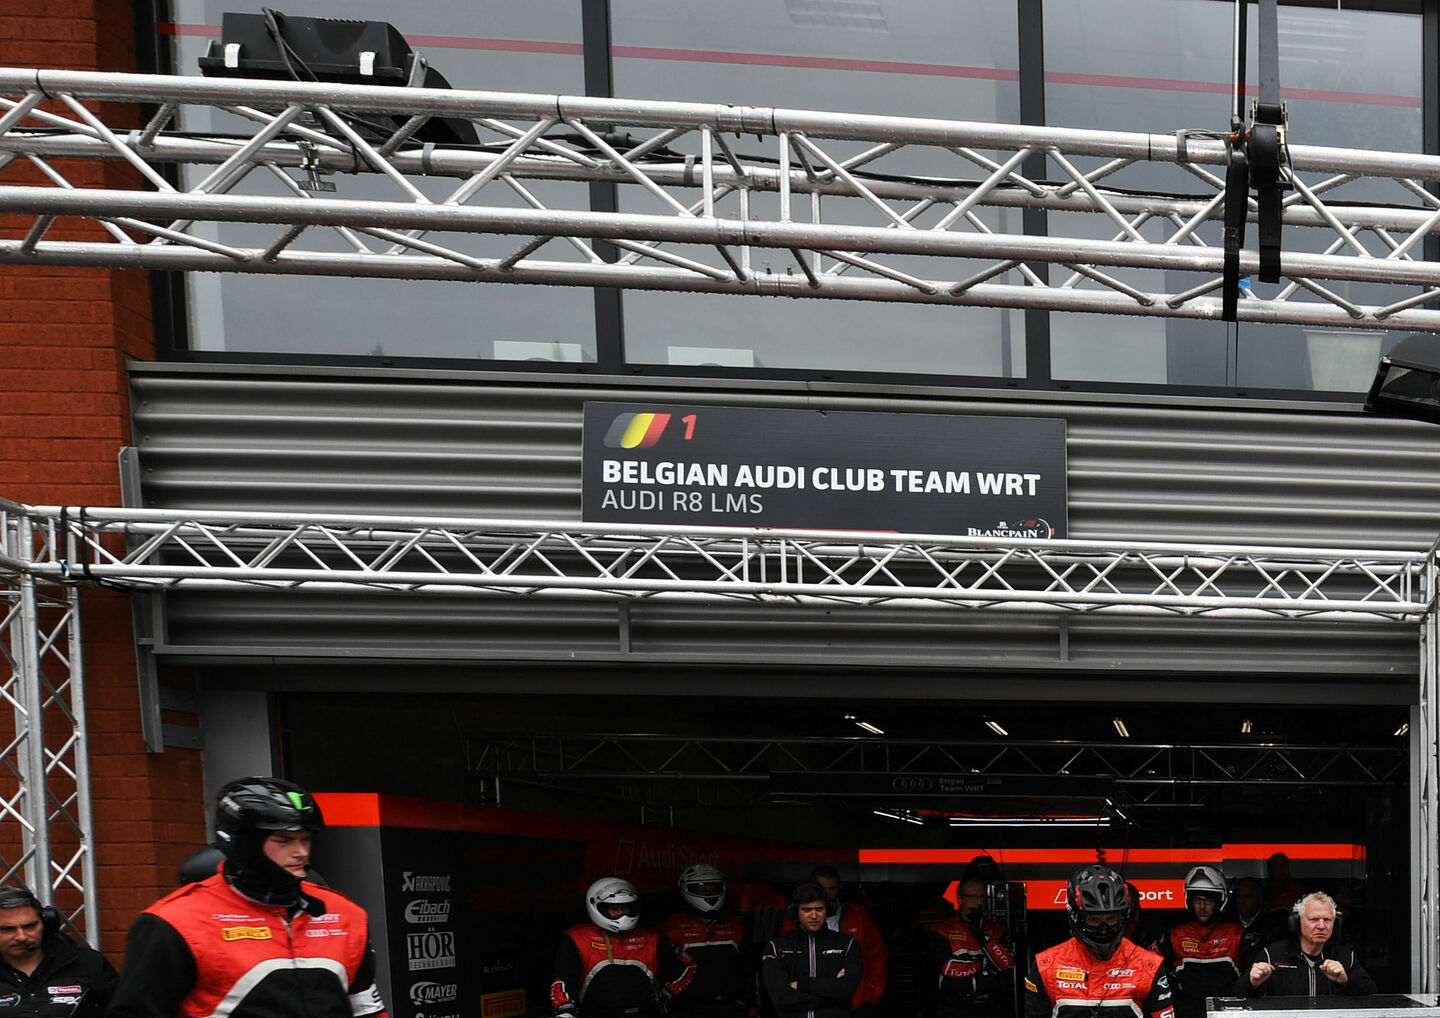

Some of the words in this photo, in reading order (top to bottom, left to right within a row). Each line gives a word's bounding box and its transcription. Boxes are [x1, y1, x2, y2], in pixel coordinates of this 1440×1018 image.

[681, 414, 696, 440] 1
[602, 460, 729, 486] BELGIAN
[735, 465, 805, 489] AUDI
[812, 467, 884, 491] CLUB
[890, 469, 970, 494] TEAM
[976, 473, 1041, 496] WRT
[601, 489, 664, 511] AUDI
[673, 491, 703, 512] R8
[712, 493, 764, 514] LMS
[967, 526, 1038, 539] BLANCPAIN
[1138, 886, 1173, 903] port
[405, 899, 450, 923] Eibach
[408, 927, 454, 959] HÖR
[425, 984, 458, 1000] MAYER
[1056, 980, 1088, 990] TOTAL
